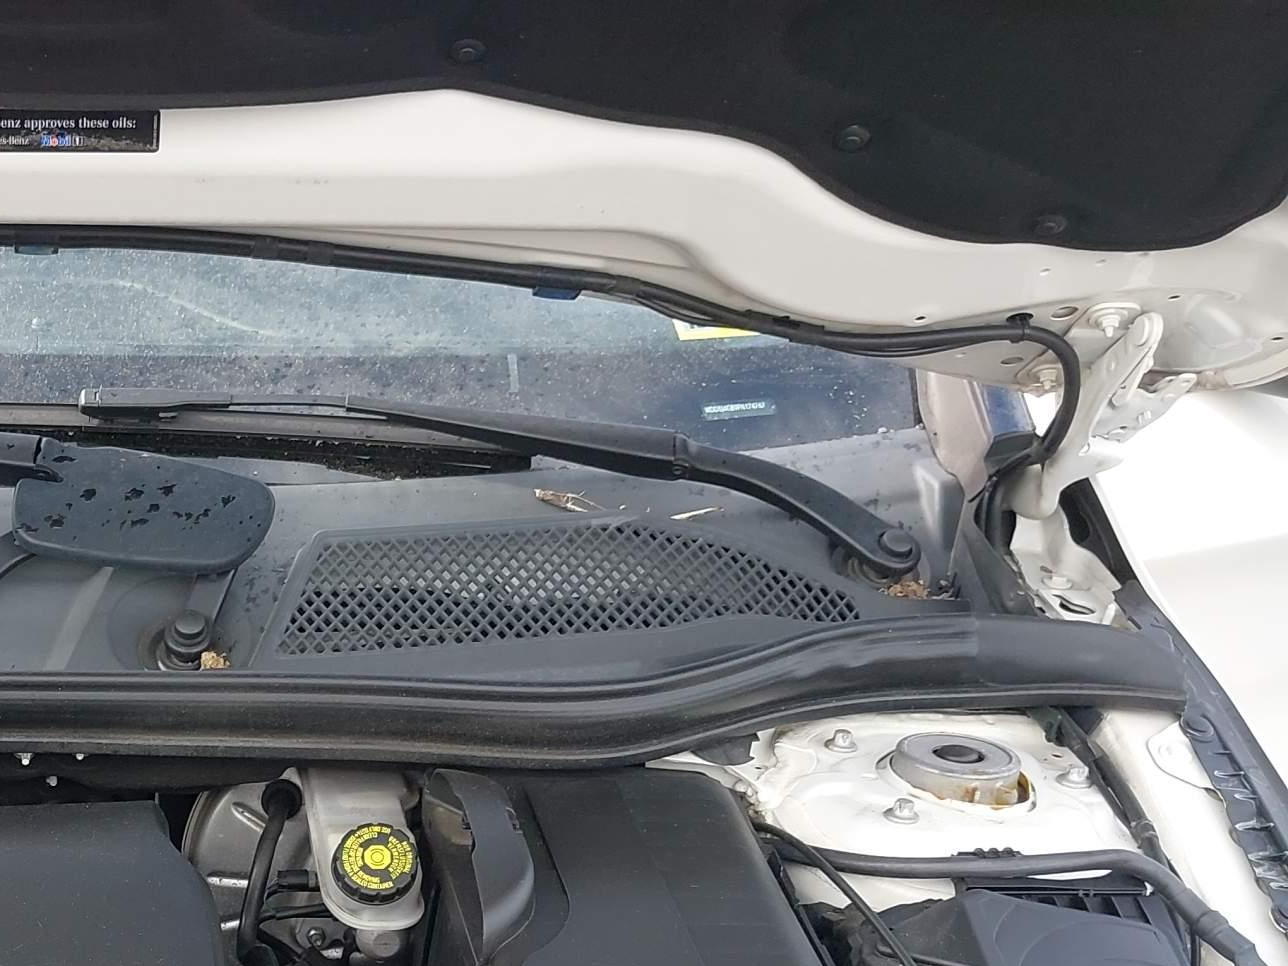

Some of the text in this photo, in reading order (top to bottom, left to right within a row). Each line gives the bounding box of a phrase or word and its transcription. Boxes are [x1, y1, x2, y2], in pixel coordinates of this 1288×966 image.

[24, 118, 75, 132] approves
[78, 117, 110, 129] these
[112, 117, 136, 129] oils:
[40, 133, 71, 147] Mobil
